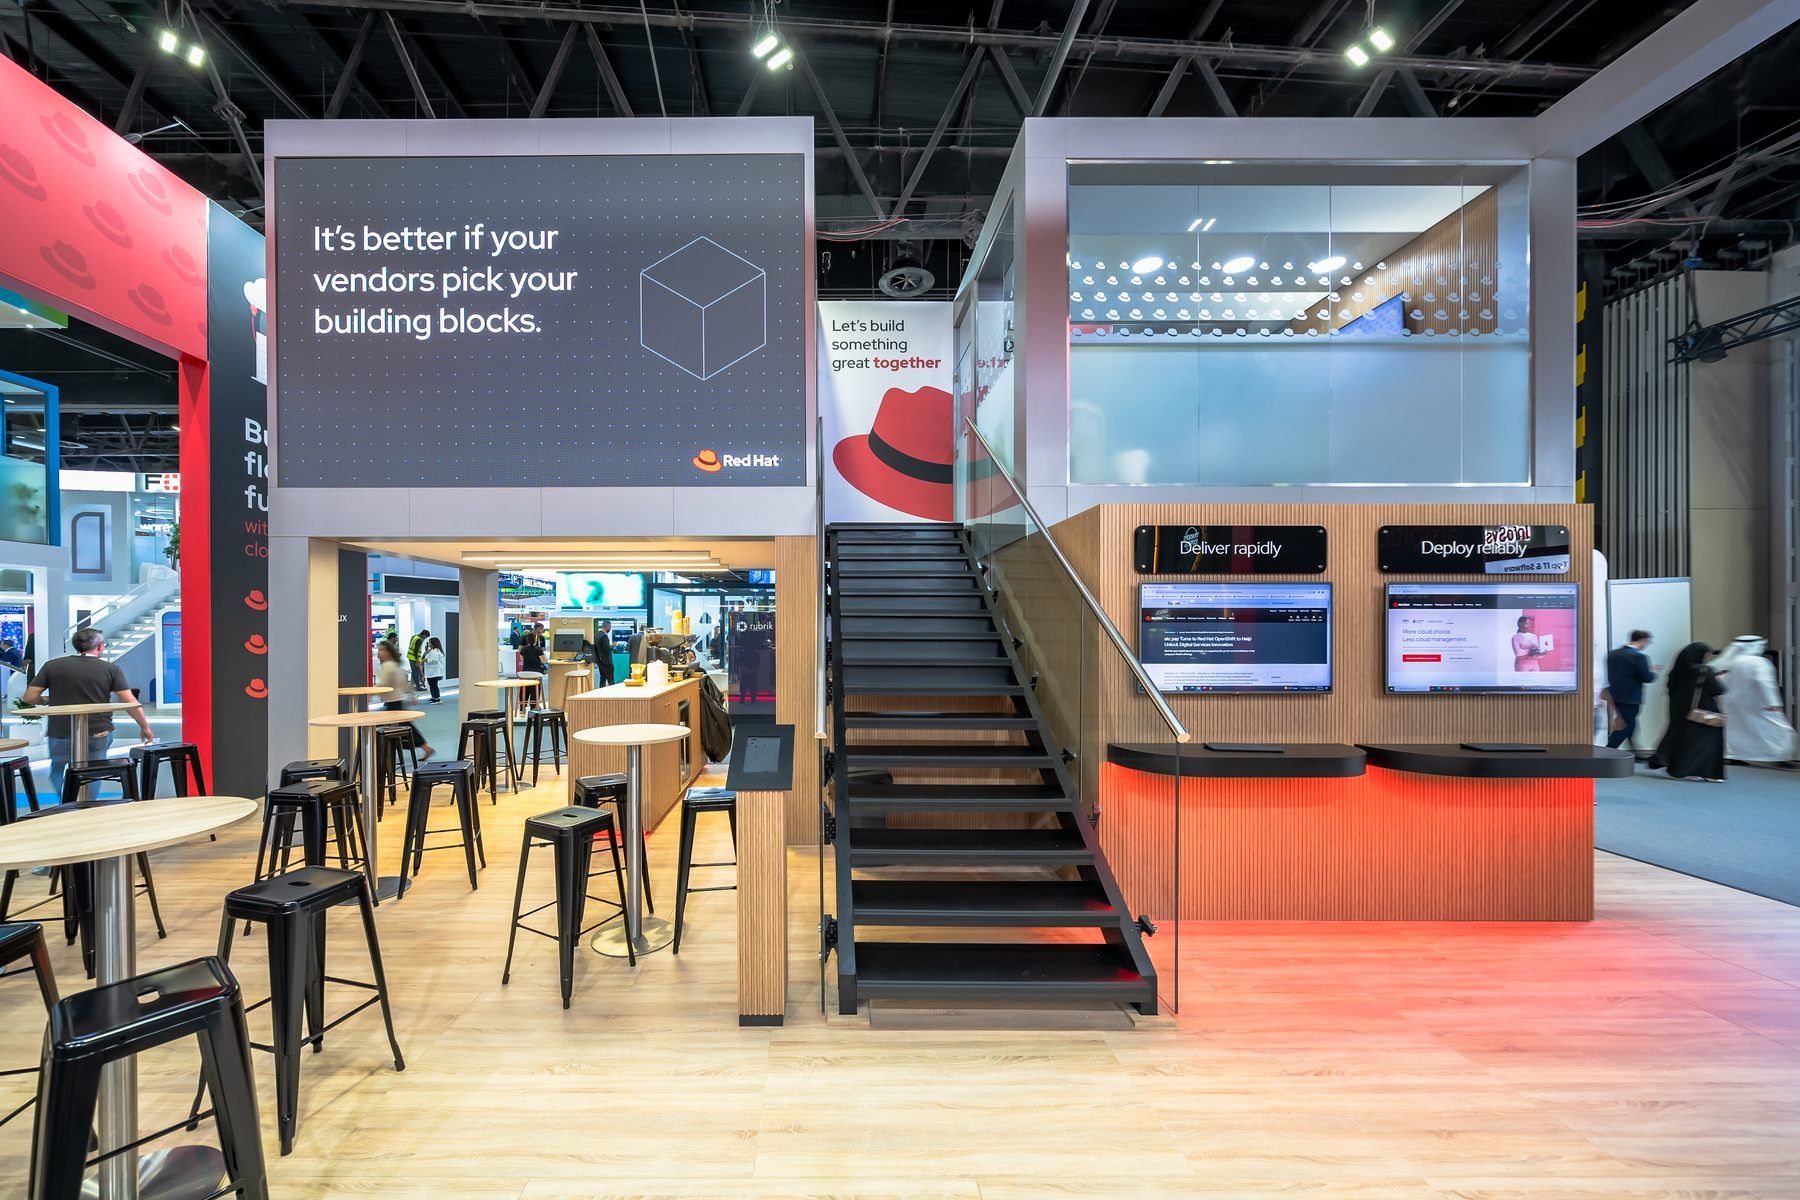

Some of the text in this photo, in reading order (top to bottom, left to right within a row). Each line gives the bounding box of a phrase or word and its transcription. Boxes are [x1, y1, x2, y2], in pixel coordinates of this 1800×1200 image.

[314, 223, 559, 257] It's better if your
[313, 266, 578, 298] vendors pick your
[314, 307, 542, 340] building blocks.
[832, 319, 905, 332] Let's build
[831, 338, 908, 353] something
[832, 356, 942, 371] great together
[244, 417, 268, 447] B
[723, 454, 780, 467] Red Hat
[1180, 541, 1282, 558] Deliver rapidly
[1421, 541, 1528, 557] Deploy reliably
[749, 621, 774, 630] rubrik
